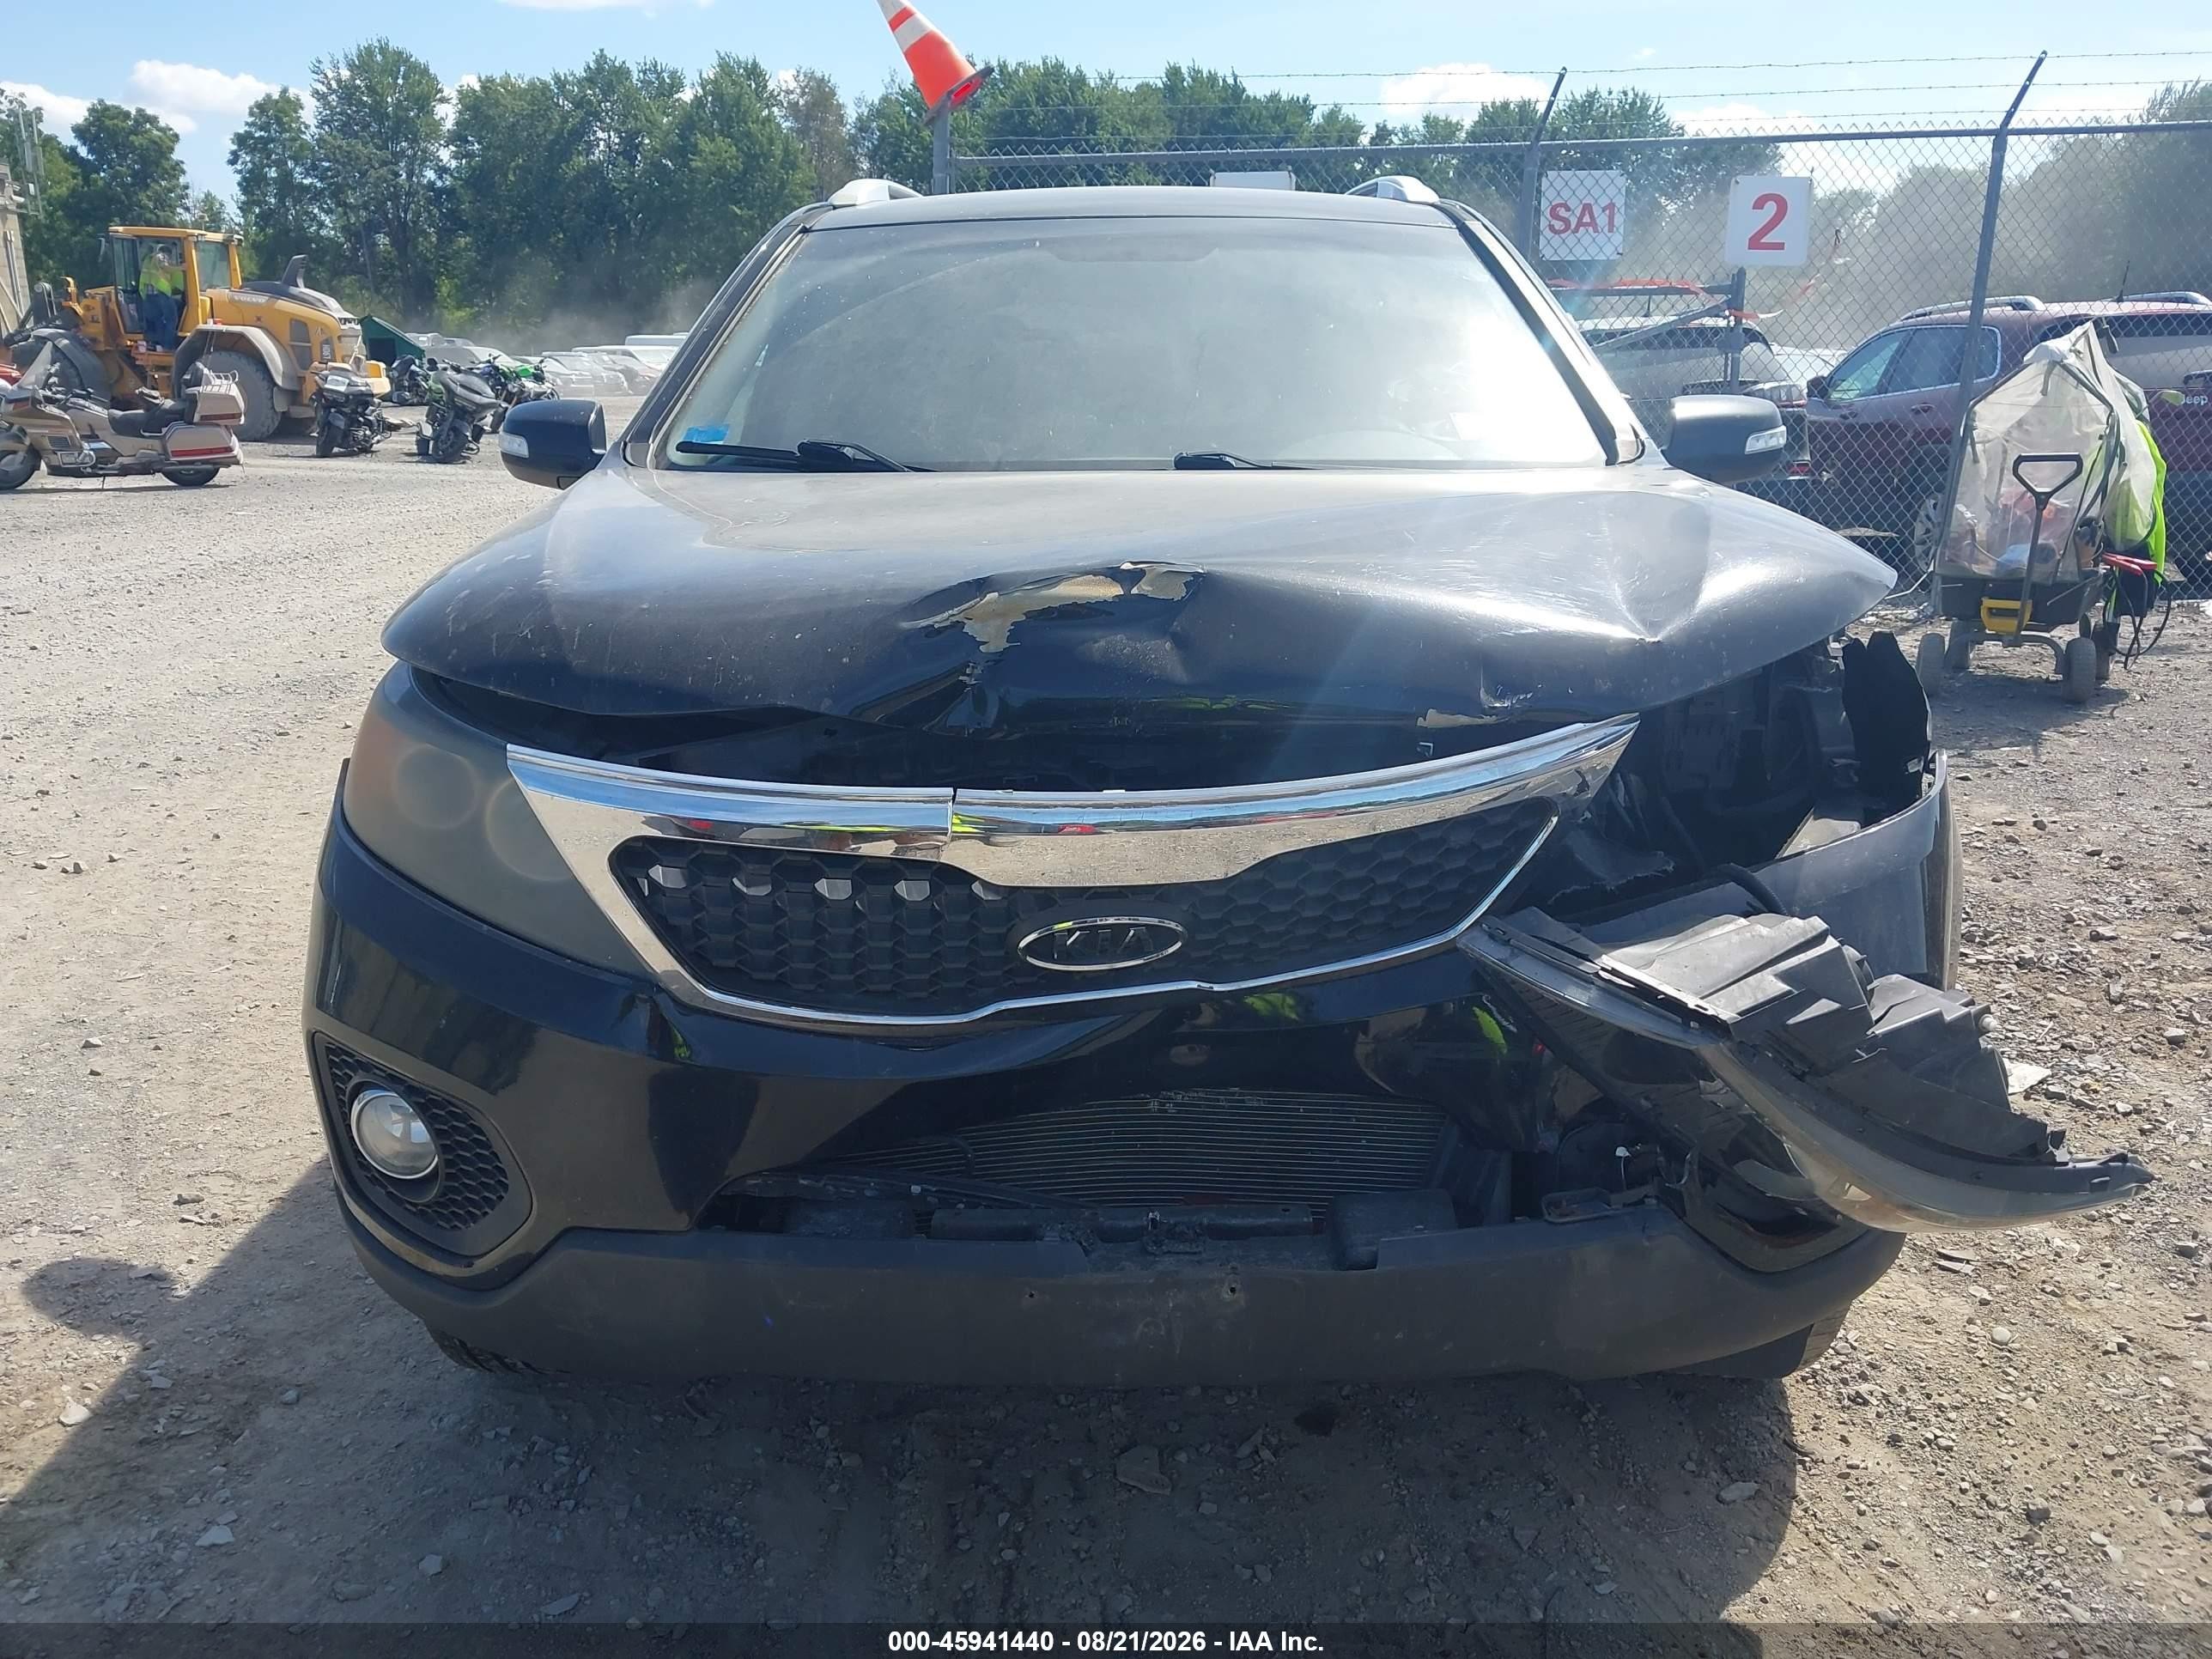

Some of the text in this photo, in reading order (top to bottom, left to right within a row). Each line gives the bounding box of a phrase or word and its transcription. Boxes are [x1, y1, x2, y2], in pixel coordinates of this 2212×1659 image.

[1547, 202, 1617, 235] SA1
[1747, 192, 1789, 251] 2
[1053, 927, 1155, 960] KIA
